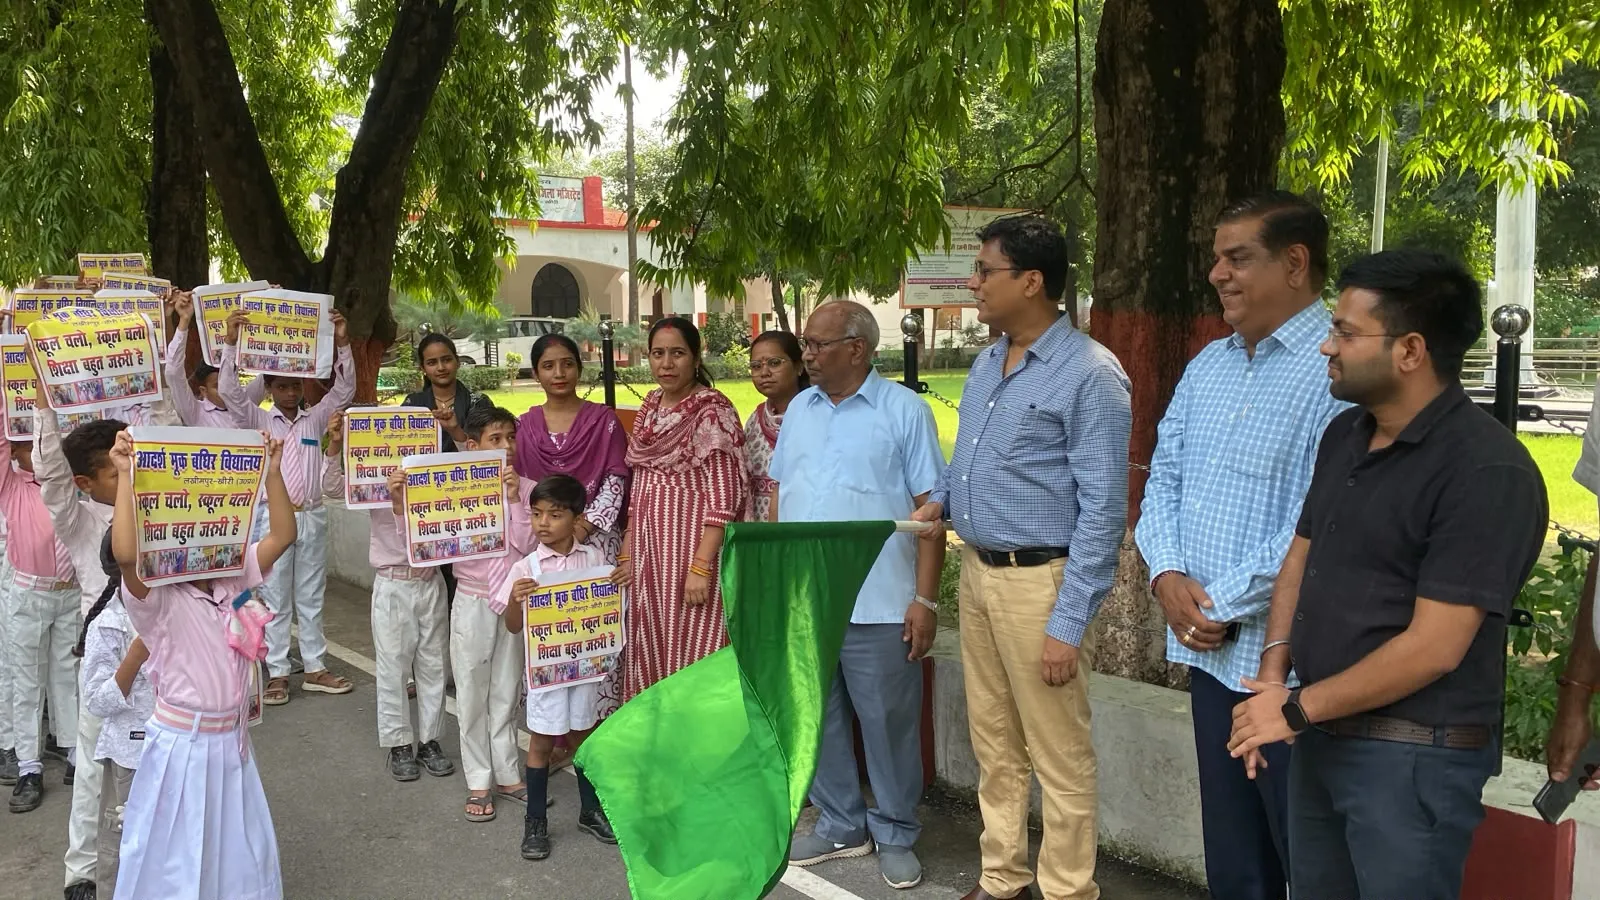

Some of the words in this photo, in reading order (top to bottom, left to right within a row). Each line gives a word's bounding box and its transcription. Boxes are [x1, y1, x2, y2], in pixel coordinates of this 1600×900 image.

[16, 297, 38, 310] आदर्श
[204, 296, 220, 309] आदर्श
[222, 297, 232, 310] मूक
[244, 300, 262, 312] आदर्श
[265, 303, 276, 315] मूक
[294, 303, 318, 317] विद्यालय
[34, 336, 61, 357] स्कूल
[63, 329, 92, 348] चलो,
[95, 328, 121, 348] स्कूल
[124, 323, 145, 340] चलो
[244, 322, 261, 336] स्कूल
[263, 322, 280, 337] चलो,
[283, 326, 300, 339] स्कूल
[301, 326, 316, 338] चलो
[247, 337, 267, 350] शिक्षा
[268, 341, 284, 354] बहुत
[305, 342, 311, 354] है
[46, 359, 80, 377] शिक्षा
[80, 355, 104, 376] बहुत
[133, 347, 144, 365] है
[7, 379, 28, 394] स्कूल
[350, 415, 371, 430] आदर्श
[373, 418, 386, 434] मूक
[407, 414, 435, 429] विद्यालय
[136, 447, 166, 468] आदर्श
[169, 452, 188, 476] मूक
[220, 449, 263, 471] विद्यालय
[350, 446, 371, 462] स्कूल
[373, 442, 393, 459] चलो,
[419, 441, 435, 454] चलो
[356, 464, 378, 479] शिक्षा
[407, 469, 431, 486] आदर्श
[432, 471, 447, 488] मूक
[470, 464, 499, 479] विद्यालय
[137, 492, 160, 516] स्कूल
[164, 489, 191, 512] चलो,
[198, 493, 227, 514] स्कूल
[229, 488, 254, 506] चलो
[410, 501, 431, 518] स्कूल
[434, 496, 455, 512] चलो,
[459, 496, 480, 512] स्कूल
[482, 491, 500, 506] चलो
[144, 520, 168, 542] शिक्षा
[172, 522, 196, 545] बहुत
[231, 515, 241, 536] है
[417, 520, 441, 536] शिक्षा
[443, 518, 462, 536] बहुत
[488, 511, 496, 527] है
[529, 589, 552, 608] आदर्श
[554, 590, 568, 609] मूक
[590, 582, 618, 598] विद्यालय
[530, 623, 552, 641] स्कूल
[555, 617, 577, 635] चलो,
[581, 616, 600, 633] स्कूल
[603, 608, 619, 625] चलो
[537, 643, 561, 660] शिक्षा
[564, 641, 582, 659] बहुत
[608, 631, 616, 647] है
